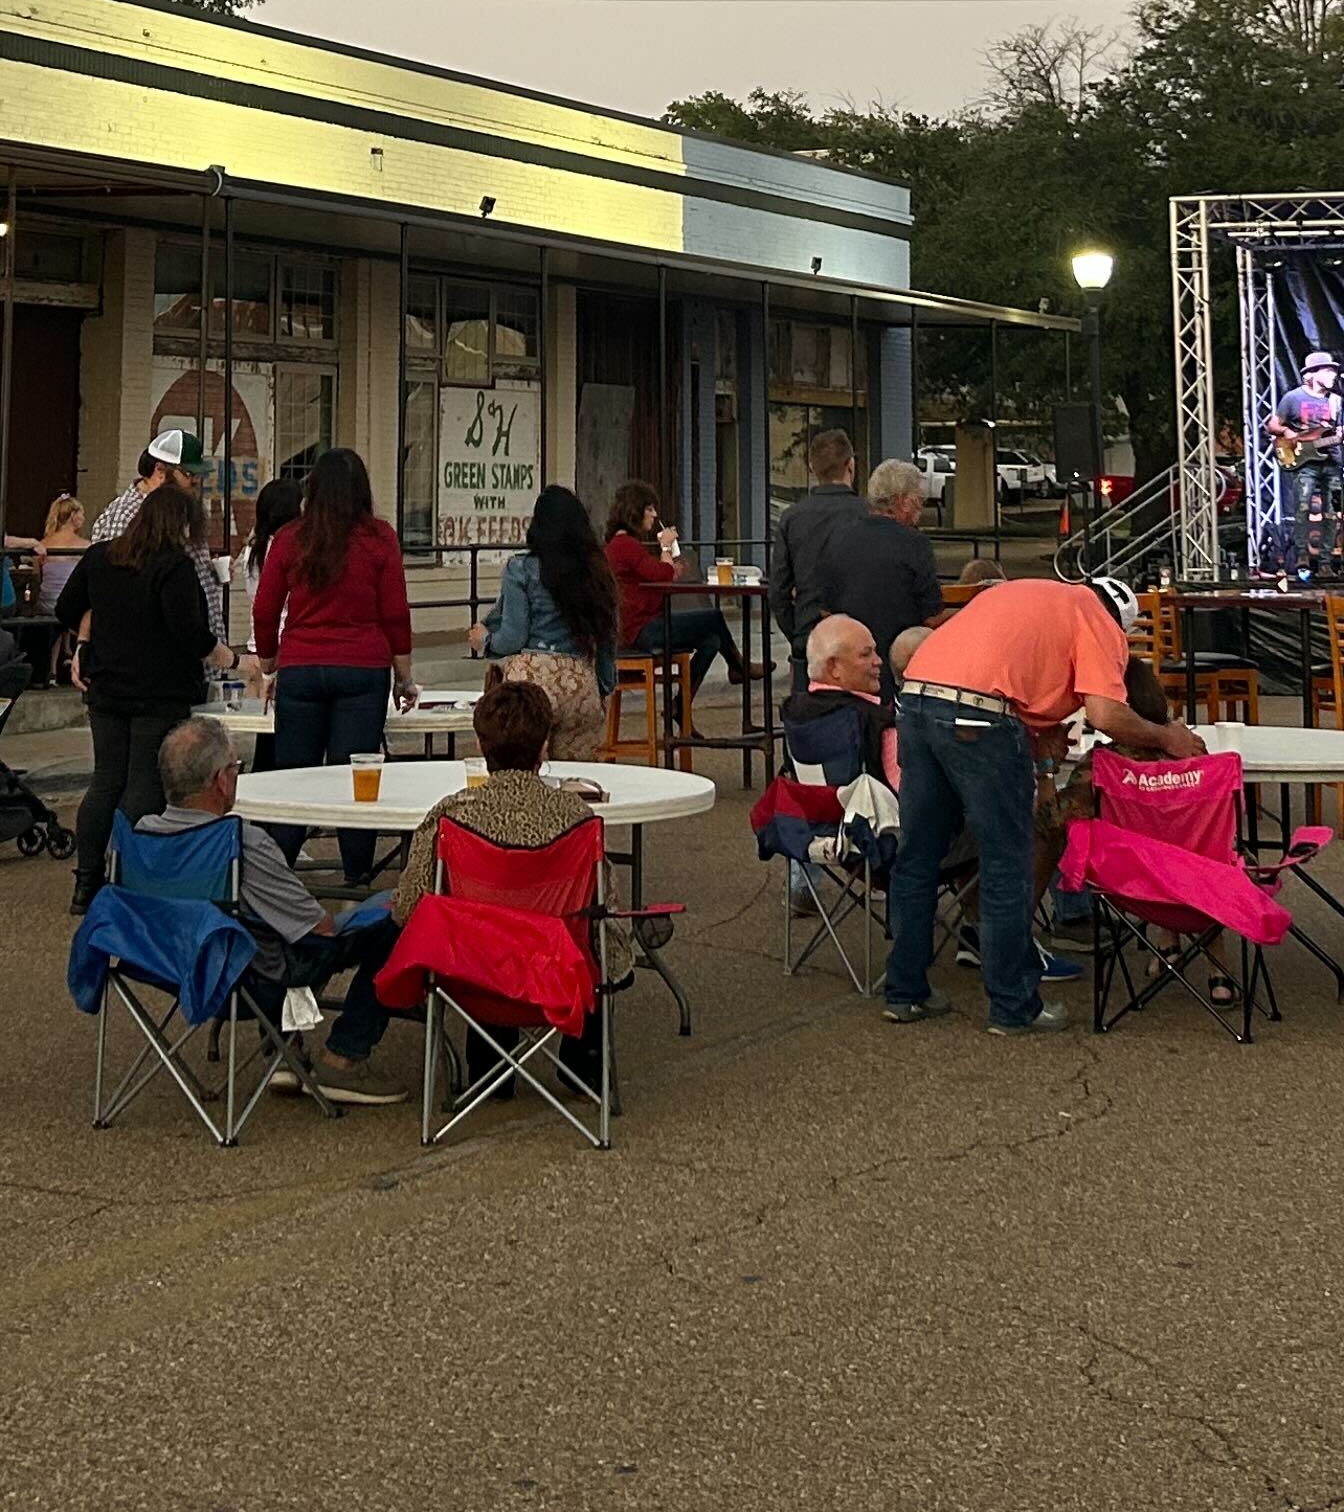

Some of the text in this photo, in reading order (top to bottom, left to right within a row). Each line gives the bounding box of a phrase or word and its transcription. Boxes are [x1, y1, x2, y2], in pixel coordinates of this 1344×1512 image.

[444, 461, 534, 490] GREEN STAMPS
[473, 494, 506, 510] WITH
[1138, 771, 1204, 787] Academy
